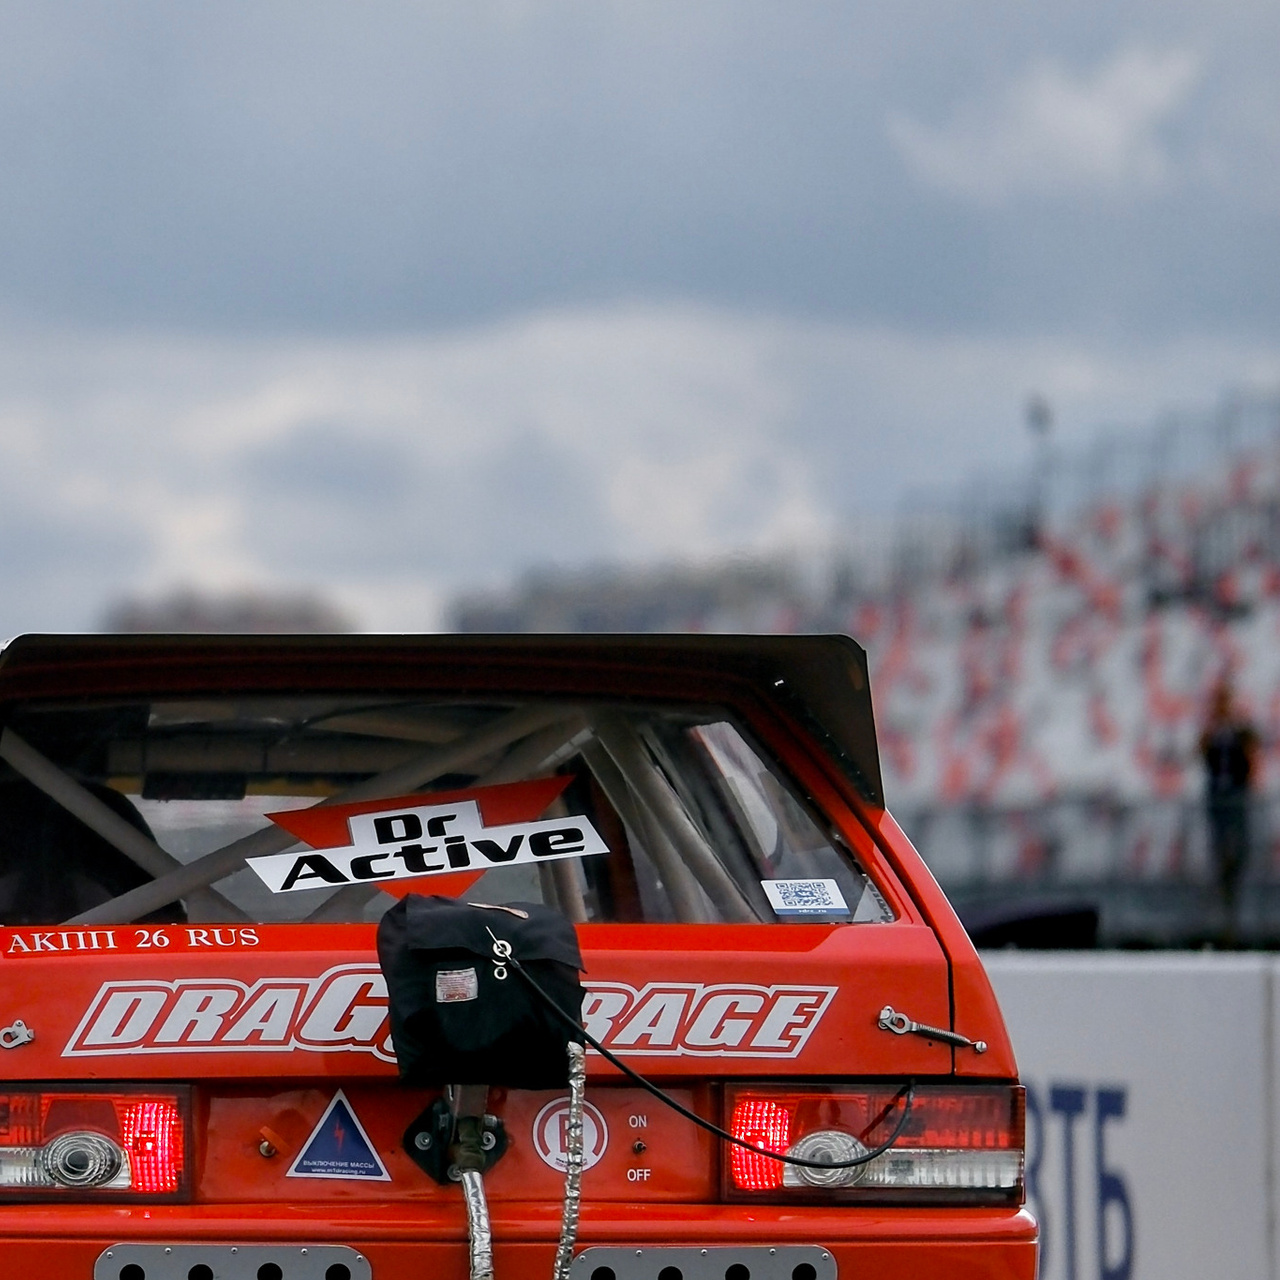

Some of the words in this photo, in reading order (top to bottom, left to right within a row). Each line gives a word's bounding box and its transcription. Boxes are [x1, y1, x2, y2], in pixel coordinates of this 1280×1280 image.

[373, 813, 457, 845] Dr
[280, 827, 586, 891] Active
[7, 930, 119, 954] АКПП
[134, 929, 170, 948] 26
[185, 928, 260, 947] RUS
[61, 963, 394, 1058] DRAG
[580, 981, 839, 1058] RAGE
[628, 1115, 647, 1128] ON
[303, 1160, 348, 1168] ВЫКЛЮЧЕНИЕ
[627, 1169, 651, 1181] OFF
